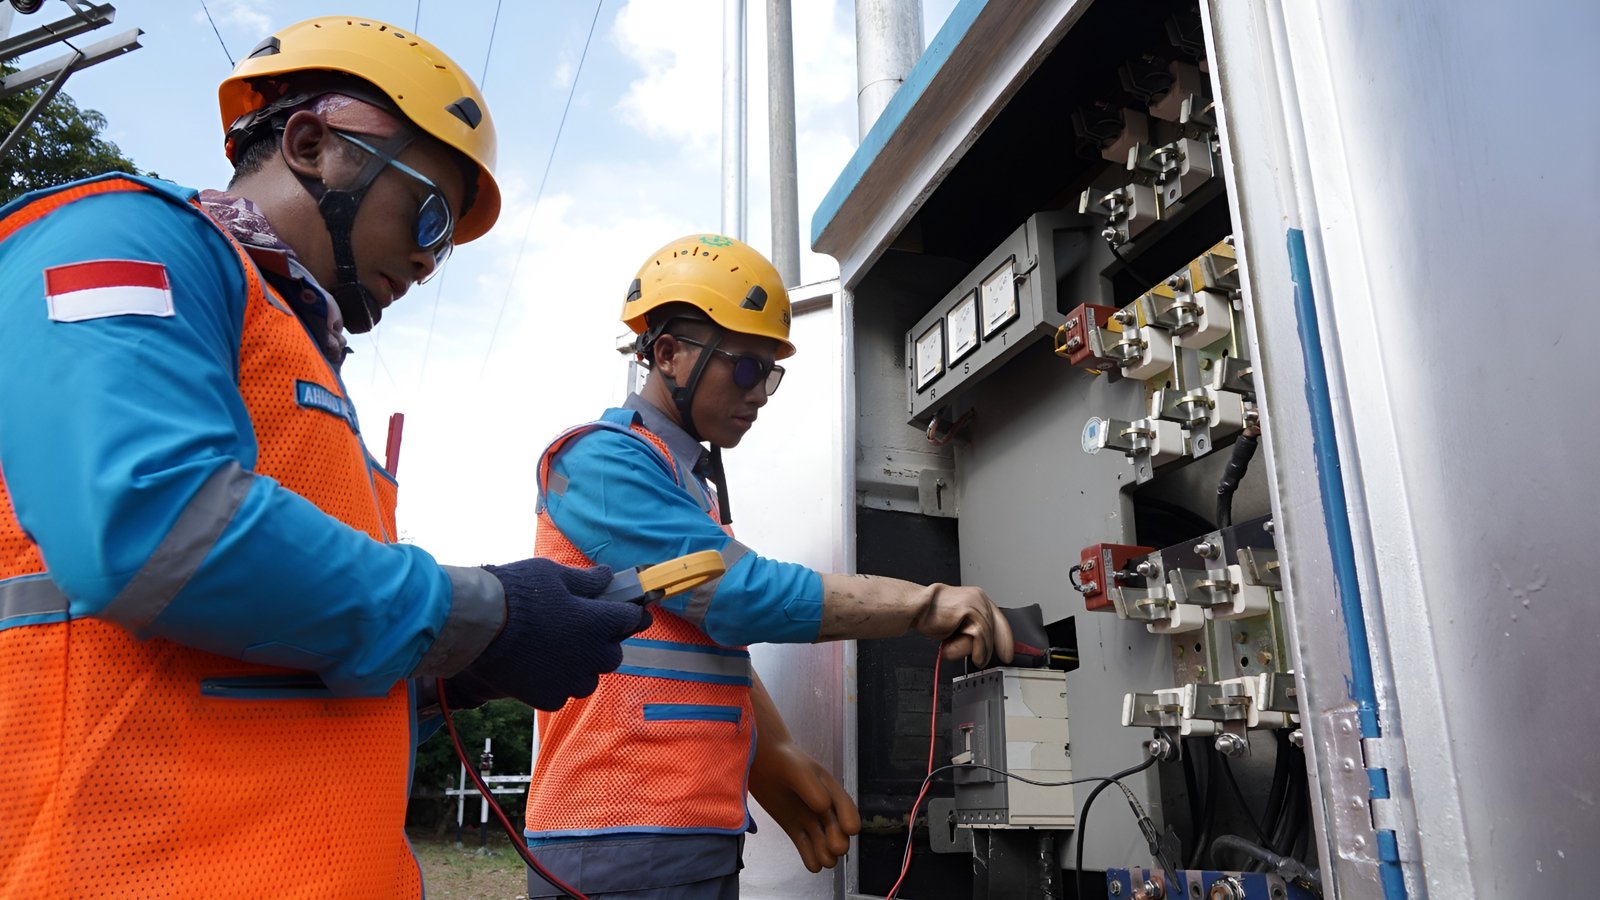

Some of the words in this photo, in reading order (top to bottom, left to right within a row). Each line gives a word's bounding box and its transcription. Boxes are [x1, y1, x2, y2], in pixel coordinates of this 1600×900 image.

[1001, 332, 1008, 346] T
[964, 362, 970, 375] S
[930, 388, 936, 400] R
